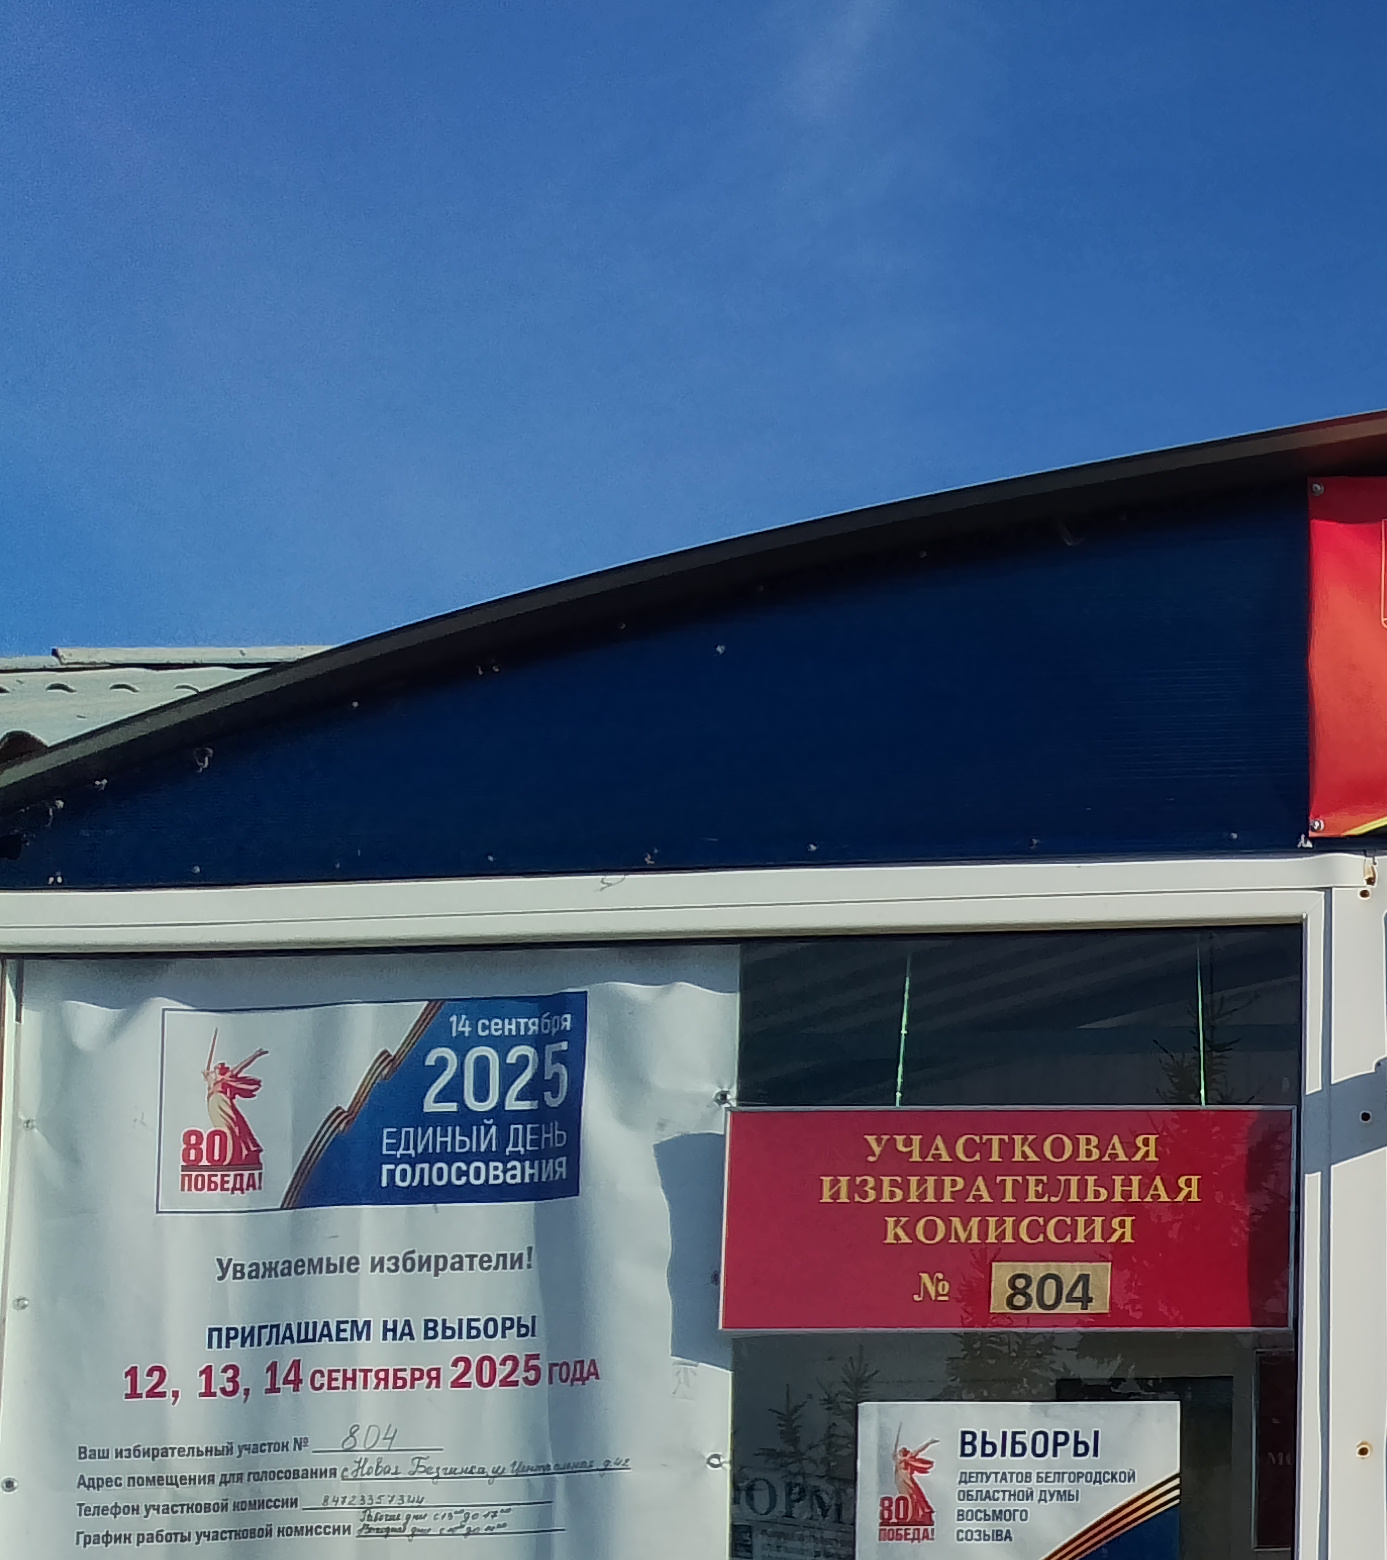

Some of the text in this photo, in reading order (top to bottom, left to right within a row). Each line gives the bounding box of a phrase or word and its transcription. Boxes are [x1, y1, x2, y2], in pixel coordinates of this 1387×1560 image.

[450, 1011, 572, 1037] 14 сентября
[424, 1043, 569, 1113] 2025
[181, 1130, 230, 1165] 80
[382, 1118, 566, 1158] ЕДИНЫЙ ДЕНЬ
[864, 1134, 1160, 1163] УЧАСТКОВАЯ
[180, 1171, 263, 1194] ПОБЕДА!
[819, 1174, 1202, 1204] ИЗБИРАТЕЛЬНАЯ
[882, 1216, 1136, 1245] КОМИССИЯ
[216, 1246, 532, 1282] Уважаемые избиратели!
[914, 1272, 1094, 1310] № 804
[206, 1316, 536, 1349] ПРИГЛАШАЕМ НА ВЫБОРЫ
[124, 1355, 599, 1405] 12, 13, 14 СЕНТЯБРЯ 2025 ГОДА
[78, 1437, 309, 1461] Ваш избирательный участок №
[341, 1423, 398, 1450] 804
[959, 1429, 1100, 1460] ВЫБОРЫ
[77, 1466, 337, 1490] Адрес помещения для голосования
[958, 1467, 1136, 1486] ДЕПУТАТОВ БЕЛГОРОДСКОЙ
[76, 1496, 298, 1518] Телефон участковой комиссии
[957, 1486, 1079, 1505] ОБЛАСТНОЙ ДУМЫ
[880, 1497, 907, 1522] 80
[957, 1509, 1028, 1522] ВОСЬМОГО
[76, 1530, 132, 1548] График
[136, 1529, 191, 1546] работы
[195, 1522, 272, 1544] участковой
[277, 1523, 351, 1538] комиссии
[879, 1527, 934, 1542] ПОБЕДА!
[956, 1528, 1012, 1543] СОЗЫВА
